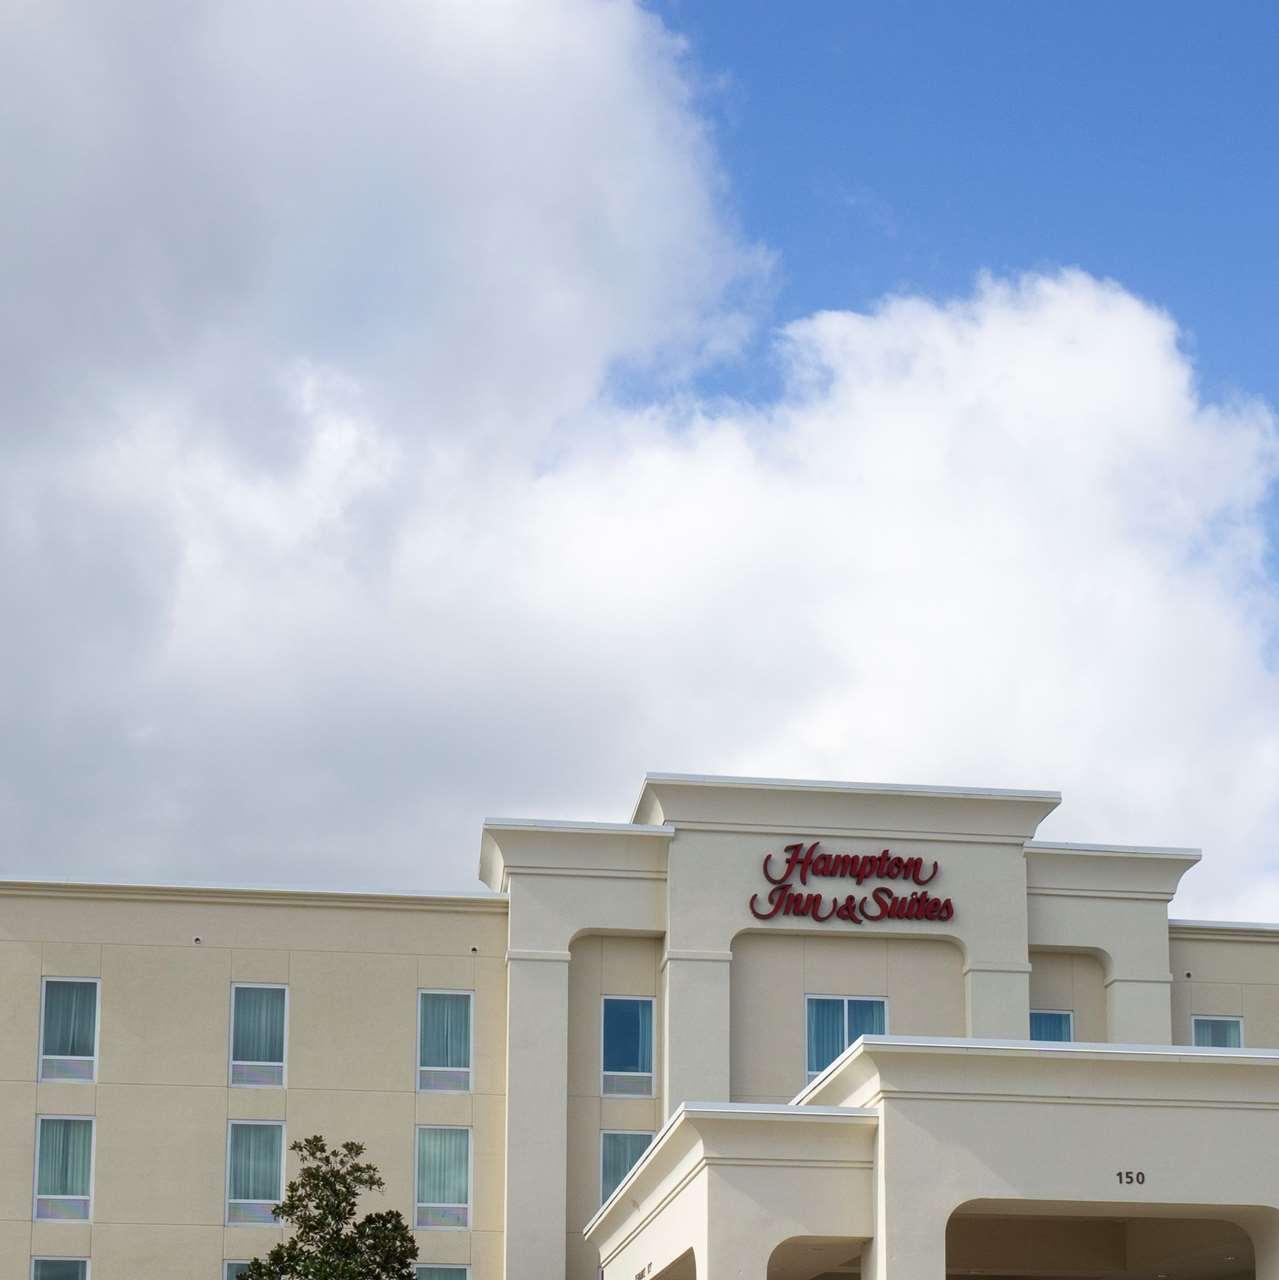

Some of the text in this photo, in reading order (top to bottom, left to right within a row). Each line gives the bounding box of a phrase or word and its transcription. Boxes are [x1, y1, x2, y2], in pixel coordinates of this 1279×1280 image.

[763, 842, 938, 886] Hampton
[749, 884, 954, 924] Inn & Suites
[1116, 1171, 1145, 1185] 150
